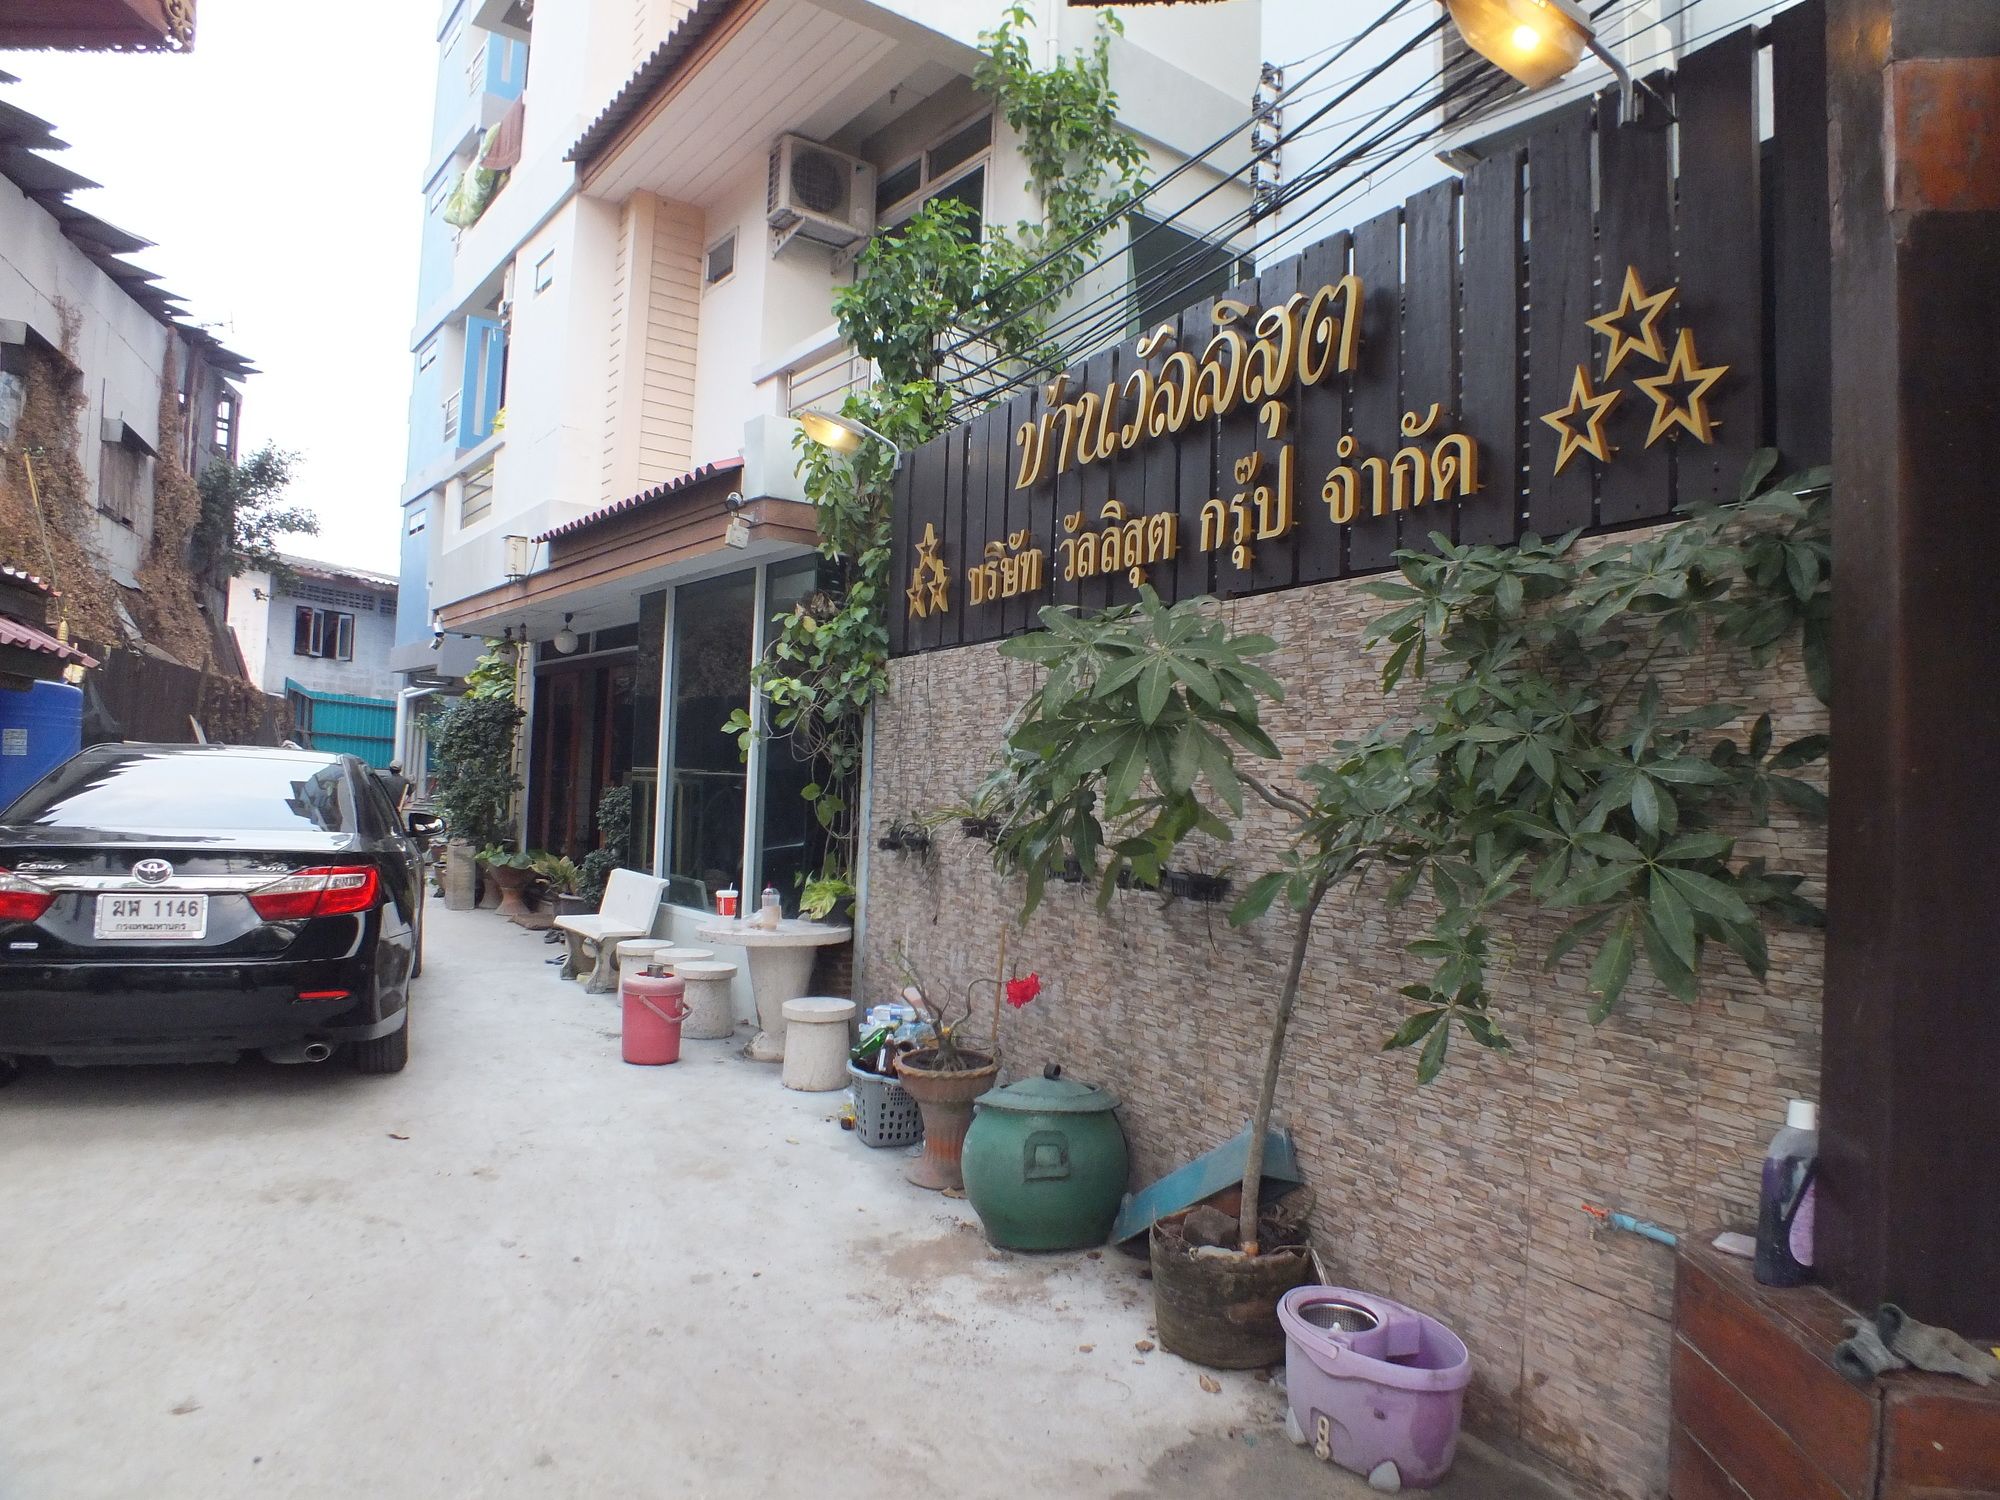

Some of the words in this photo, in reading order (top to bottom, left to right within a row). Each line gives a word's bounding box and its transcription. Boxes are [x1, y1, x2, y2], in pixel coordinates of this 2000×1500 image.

[1015, 275, 1364, 490] บ้านวัลลิสุต
[968, 529, 1043, 607] บริษัท
[1059, 499, 1178, 589] วัลลิสุต
[1200, 444, 1294, 570] กรุ๊ป
[1321, 402, 1479, 525] จำกัด
[154, 899, 199, 918] 1146
